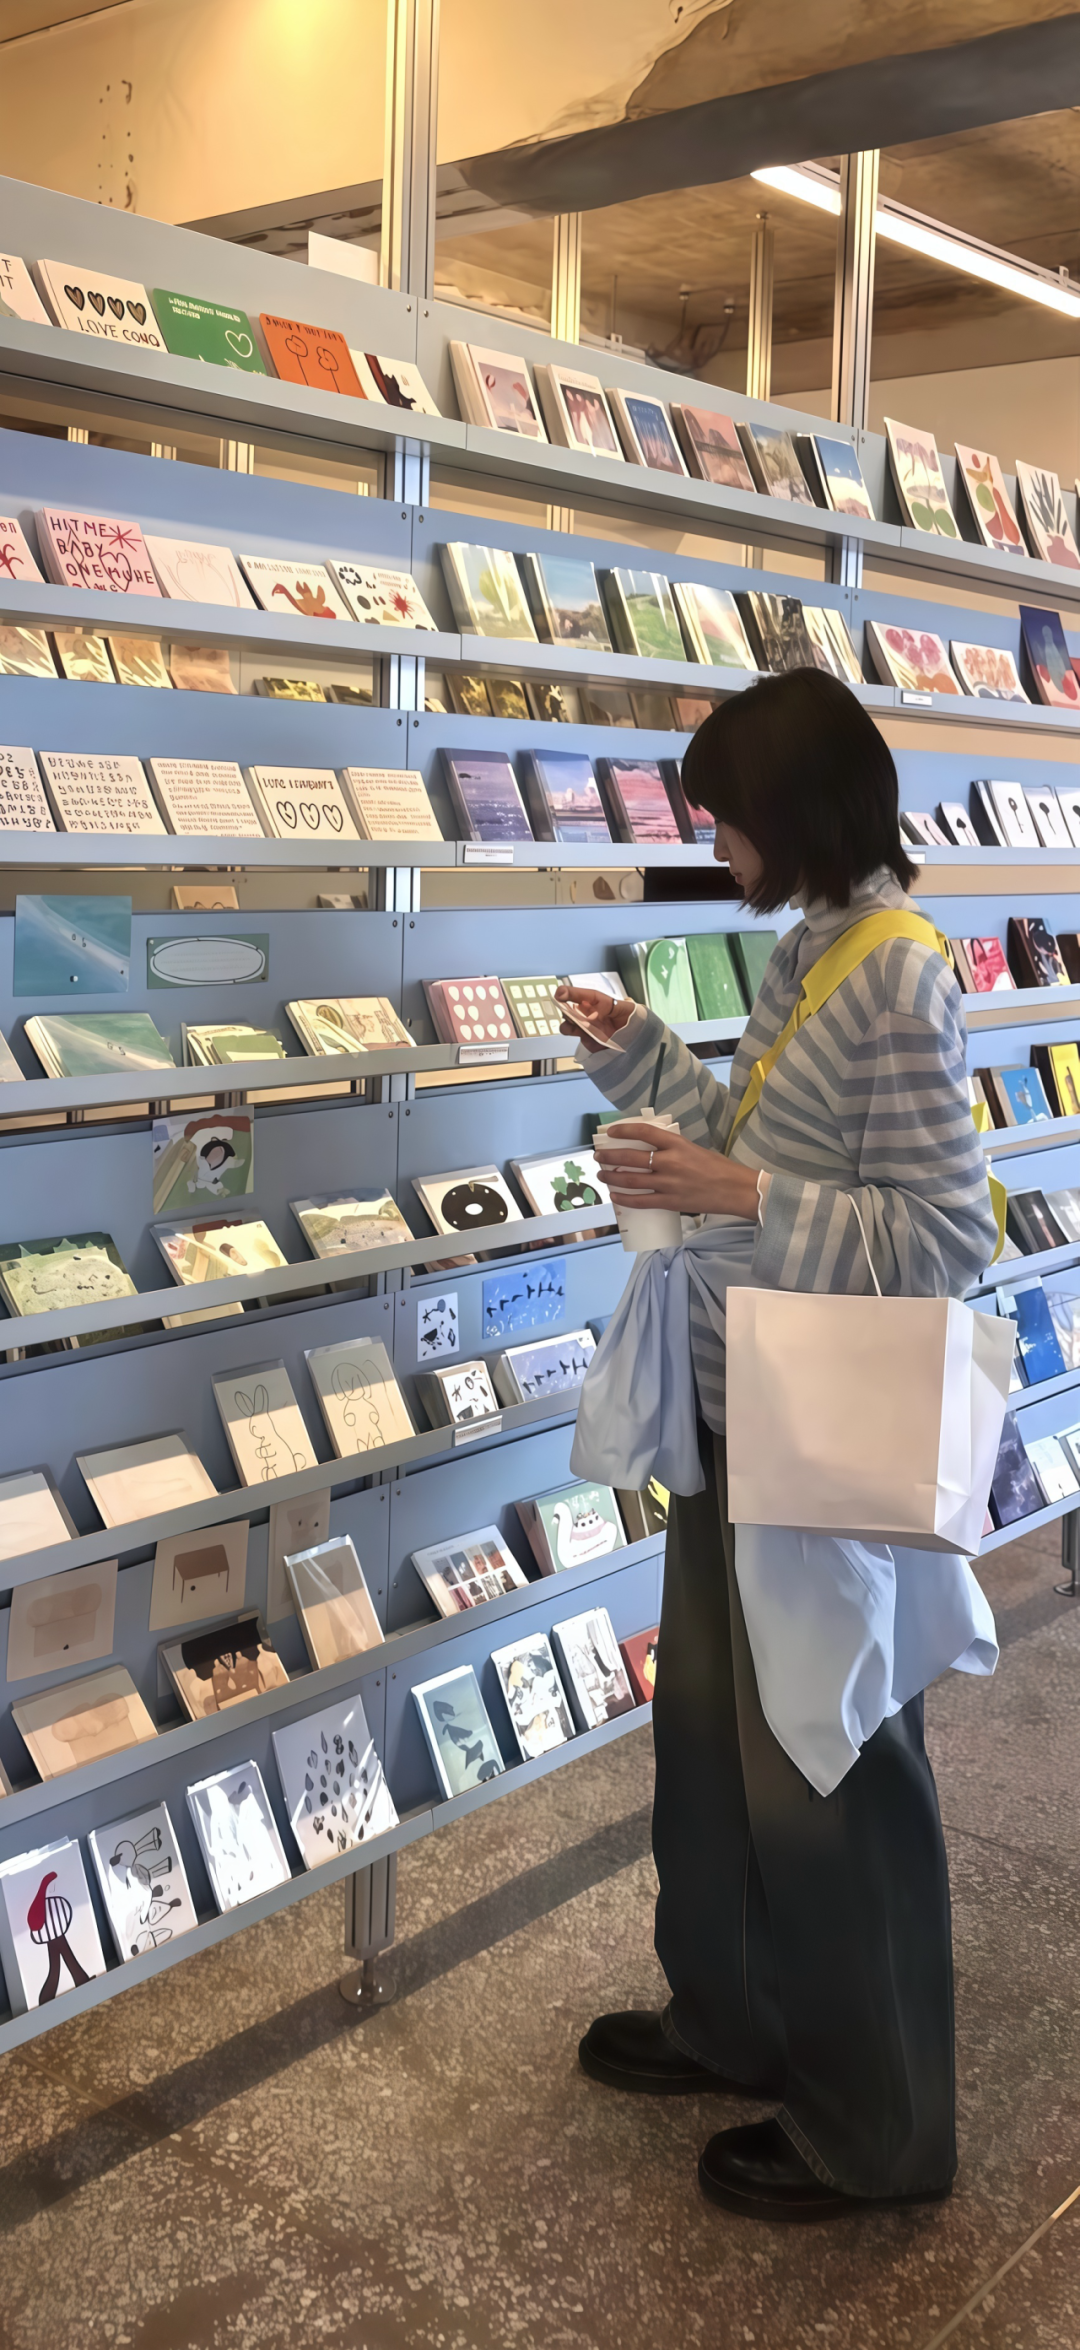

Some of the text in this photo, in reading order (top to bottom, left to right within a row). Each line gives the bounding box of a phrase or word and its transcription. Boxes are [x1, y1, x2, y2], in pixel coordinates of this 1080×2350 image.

[77, 316, 118, 338] LOVE
[49, 516, 107, 537] HIT ME
[56, 538, 103, 558] BABY
[66, 562, 103, 578] ONE
